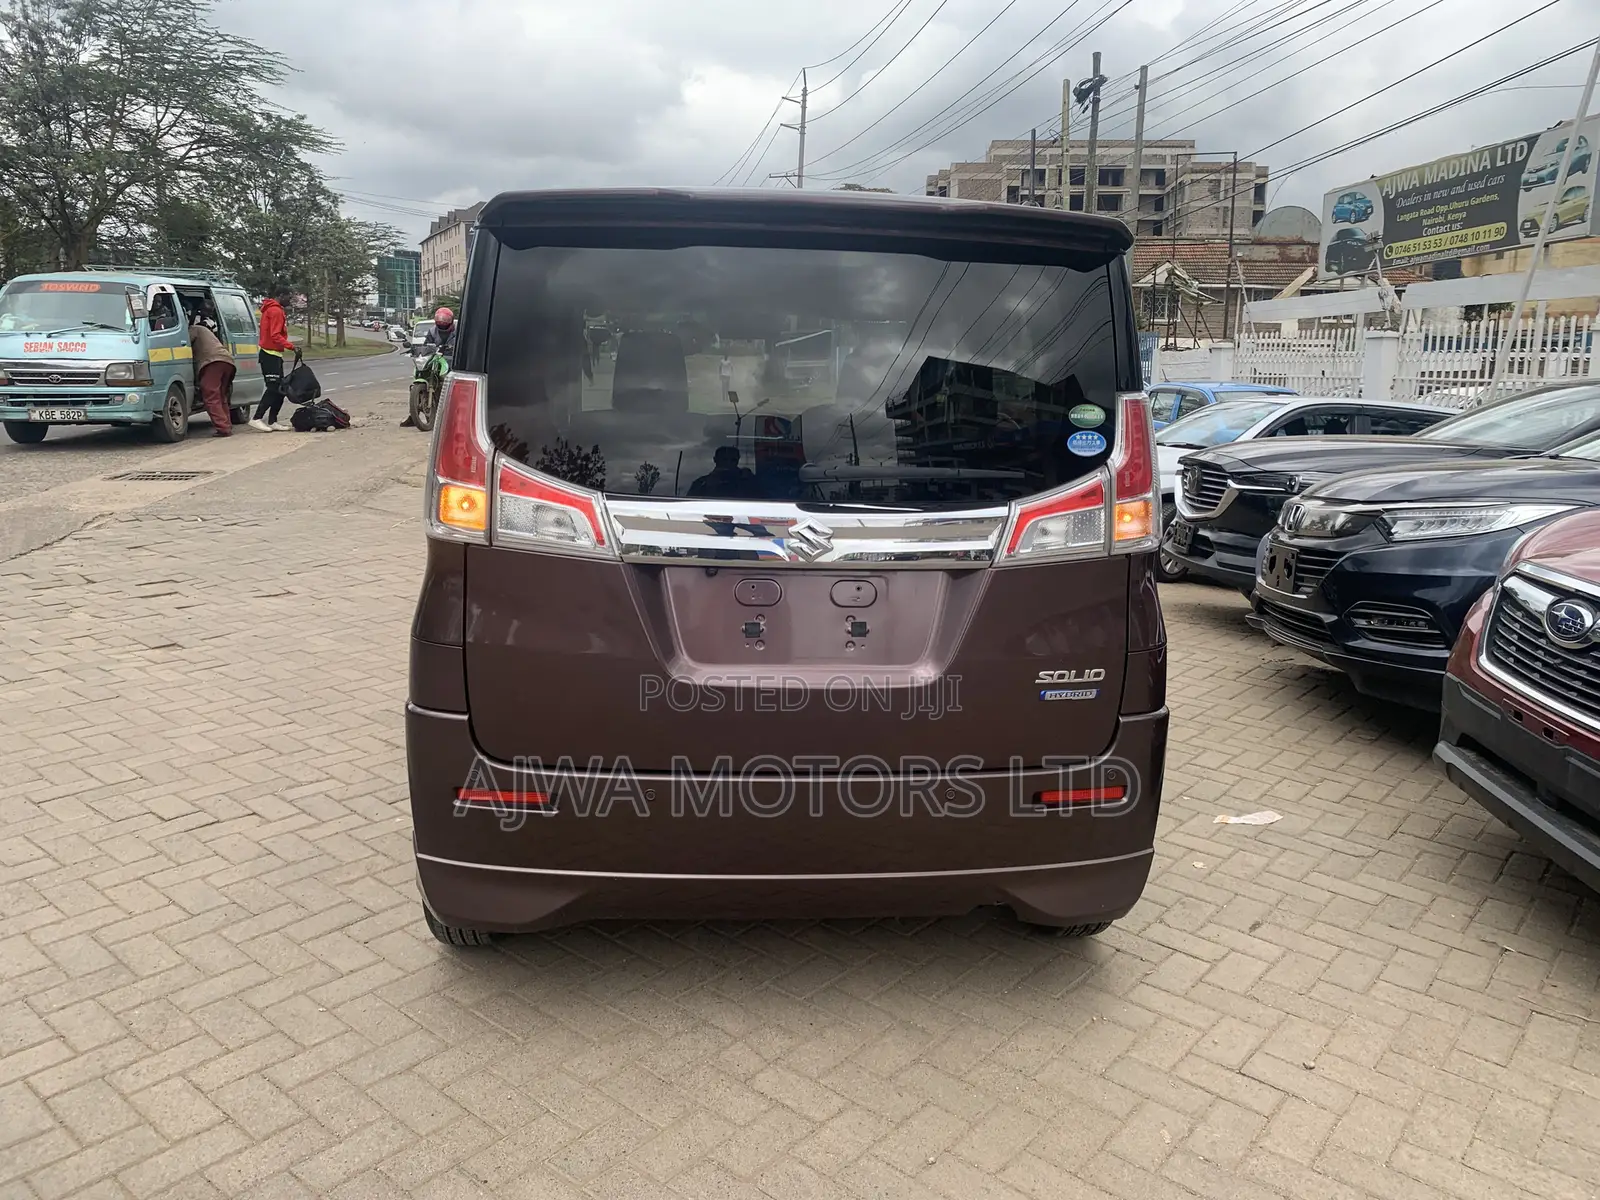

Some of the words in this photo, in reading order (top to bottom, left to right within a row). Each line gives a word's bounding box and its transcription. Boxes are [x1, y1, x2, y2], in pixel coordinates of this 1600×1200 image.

[1382, 171, 1420, 199] AJWA
[1424, 150, 1491, 186] MADINA
[1496, 140, 1528, 167] LTD
[1396, 192, 1423, 208] Dealers
[1423, 190, 1432, 201] in
[1433, 188, 1450, 199] new
[1450, 179, 1468, 195] and
[1467, 174, 1489, 191] used
[1487, 174, 1506, 187] cars
[1396, 211, 1419, 222] Langata
[1420, 205, 1435, 216] Road
[1422, 214, 1446, 226] Nairobi,
[1447, 211, 1467, 221] Kenya
[1422, 224, 1451, 236] Contact
[1451, 222, 1464, 231] us:
[1395, 244, 1412, 255] 0746
[1412, 242, 1421, 252] 51
[1422, 240, 1432, 251] 53
[1433, 238, 1443, 248] 53
[1443, 236, 1449, 247] /
[1450, 233, 1469, 246] 0748
[1470, 231, 1481, 242] 10
[1483, 229, 1492, 240] 11
[1494, 226, 1505, 238] 90
[57, 341, 87, 353] SACCO
[39, 410, 56, 420] KBE
[60, 410, 82, 420] 582P
[1035, 668, 1106, 683] SOLIO
[1049, 691, 1093, 699] HYBRID
